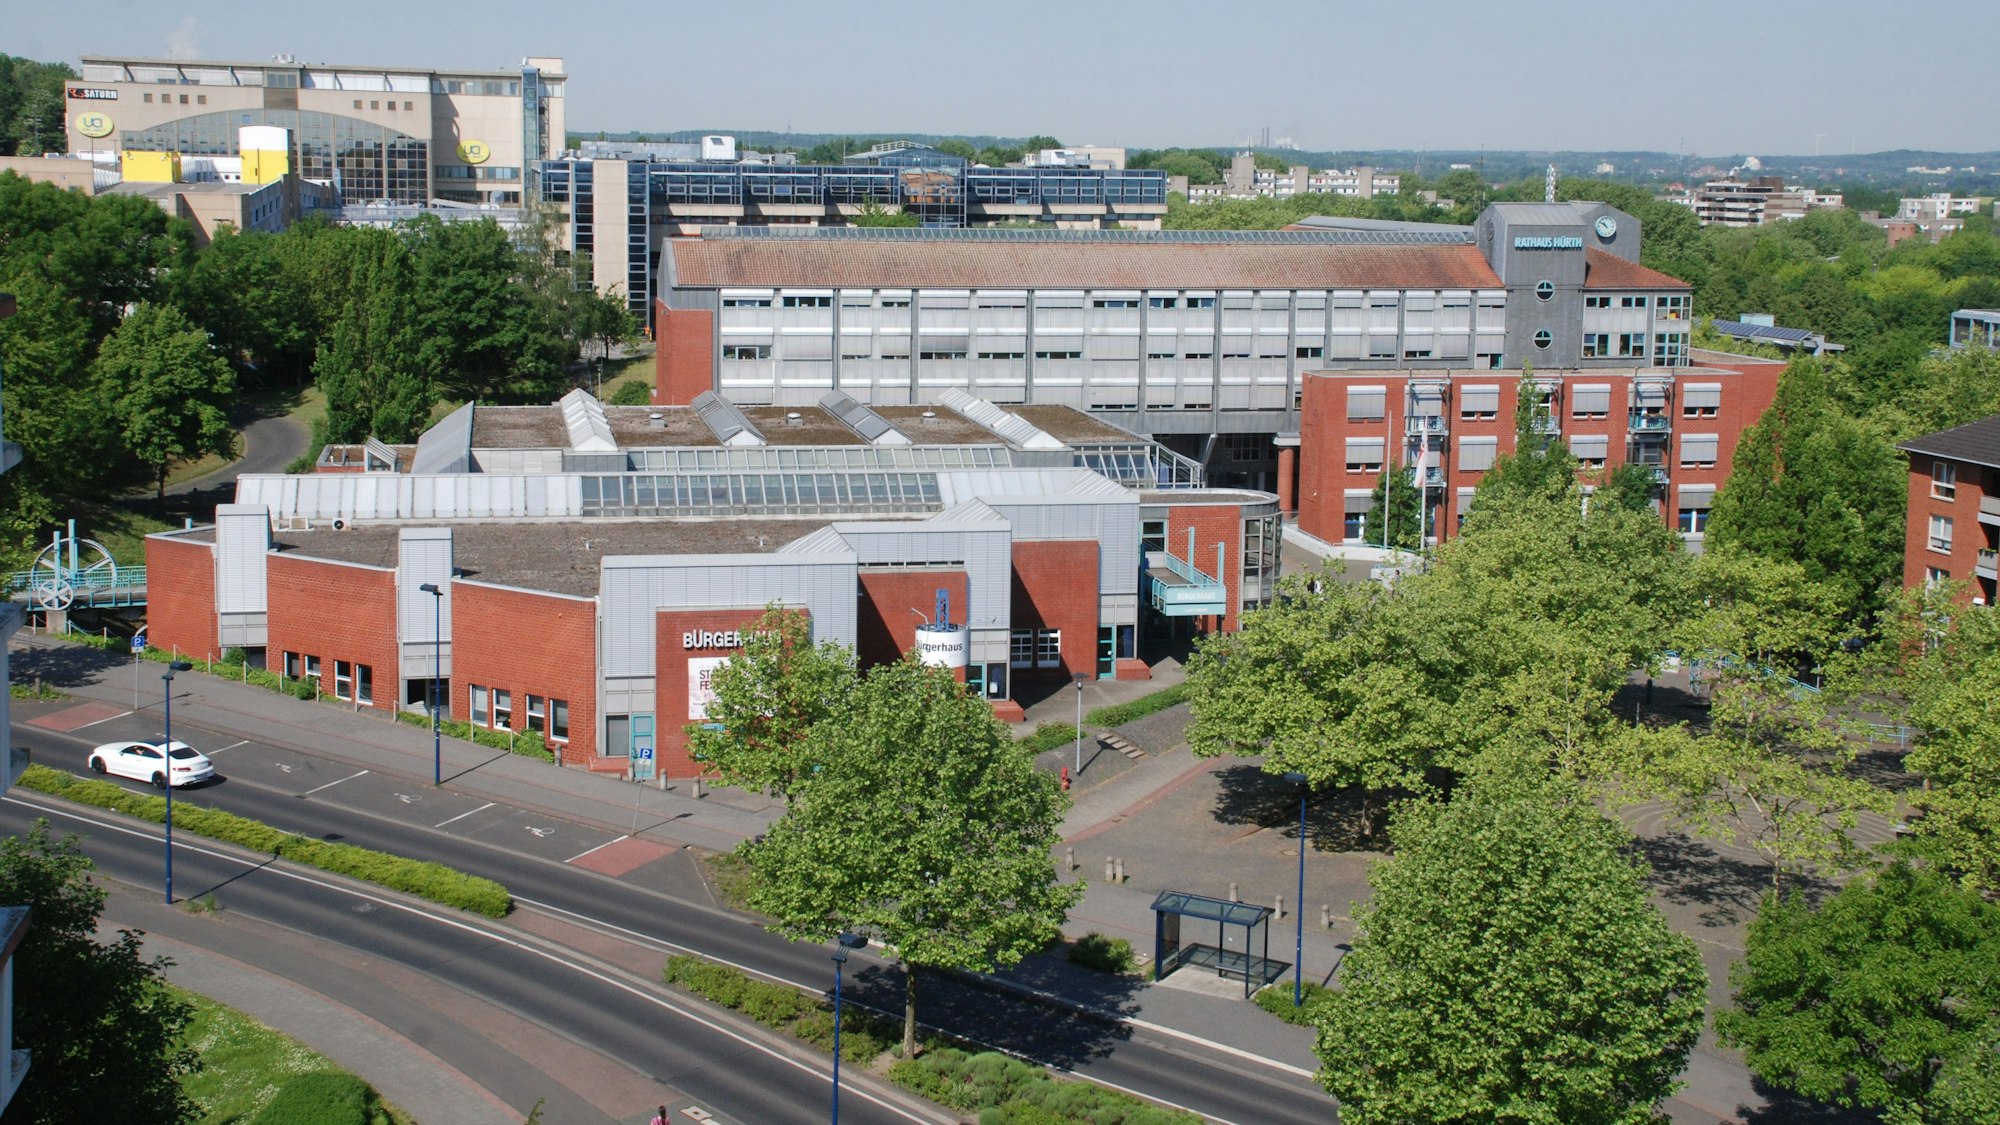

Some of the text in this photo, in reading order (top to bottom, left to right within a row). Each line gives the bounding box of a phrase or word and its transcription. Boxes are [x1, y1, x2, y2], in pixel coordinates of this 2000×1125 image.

[84, 89, 118, 99] SATURN
[1514, 235, 1582, 248] RATHAUS HÜRTH
[134, 637, 142, 646] P
[683, 629, 782, 648] BÜRGER
[642, 749, 651, 758] P
